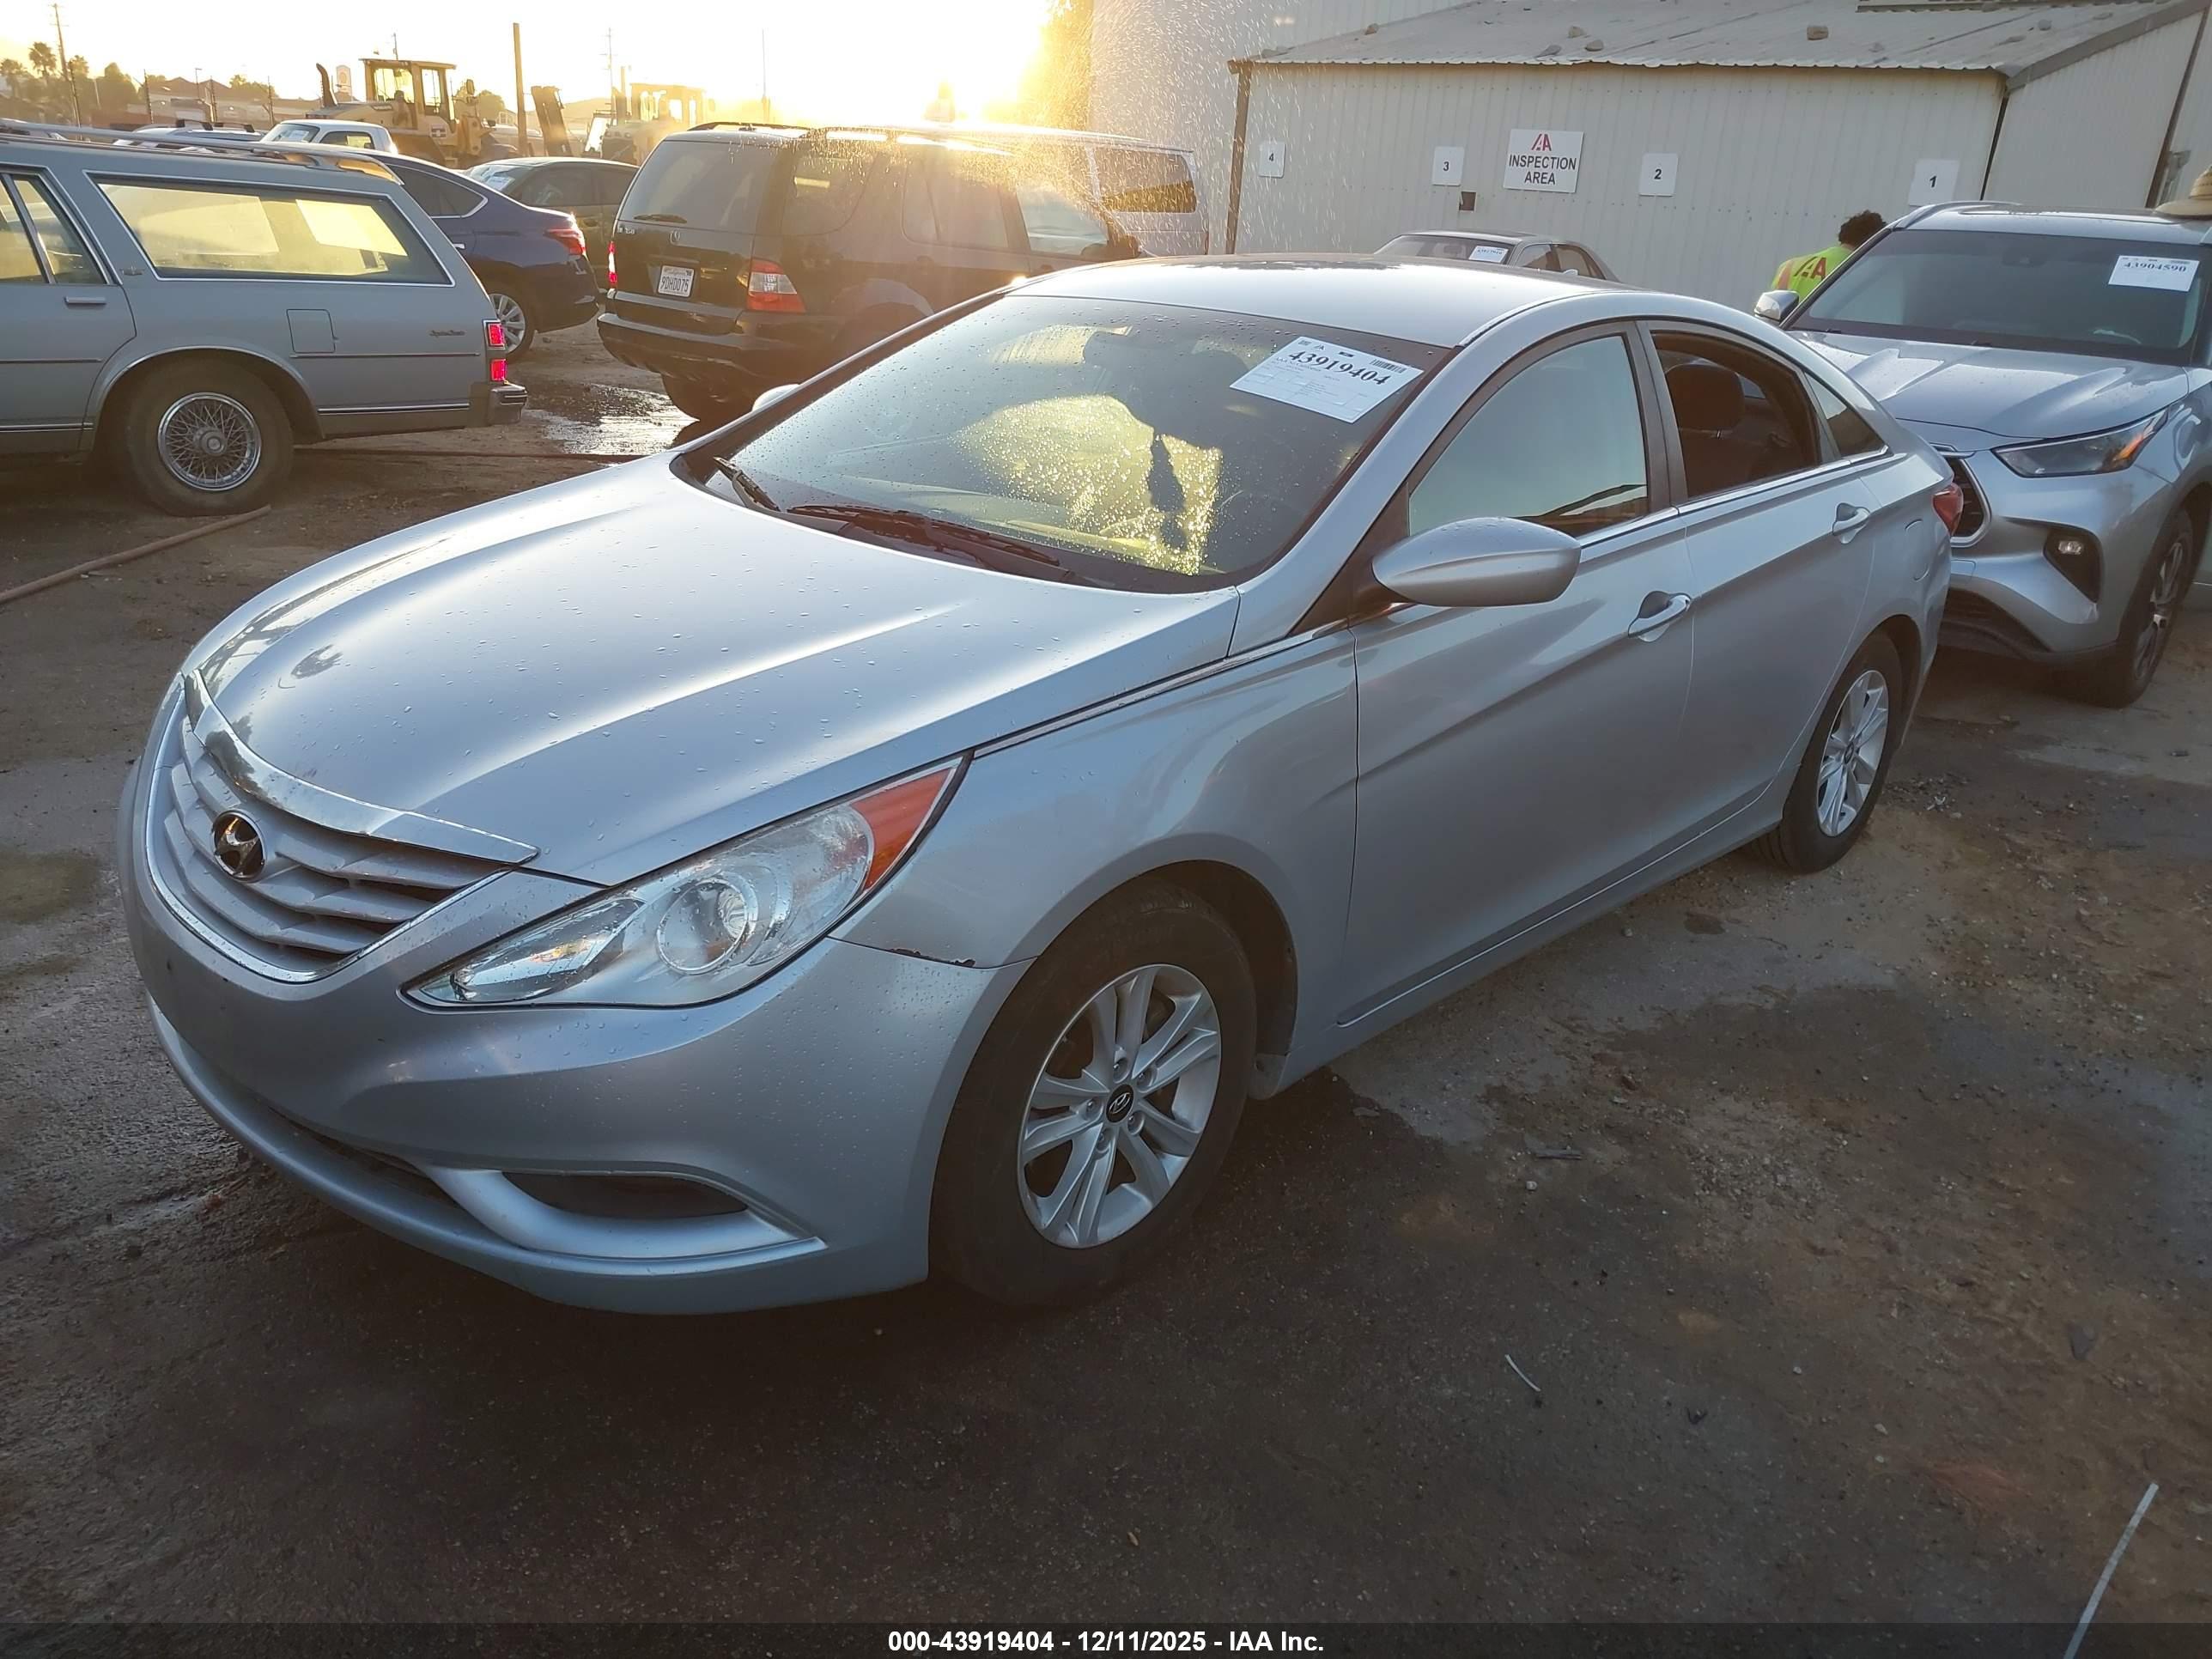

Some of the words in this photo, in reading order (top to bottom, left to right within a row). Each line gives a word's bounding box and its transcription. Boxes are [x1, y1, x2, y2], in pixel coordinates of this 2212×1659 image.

[1268, 153, 1274, 161] 4
[1509, 155, 1577, 170] INSPECTION
[1443, 161, 1449, 172] 3
[1524, 171, 1556, 185] AREA
[1654, 168, 1662, 179] 2
[1929, 175, 1936, 188] 1
[2124, 262, 2187, 272] 43904590
[1289, 349, 1391, 386] 43919404
